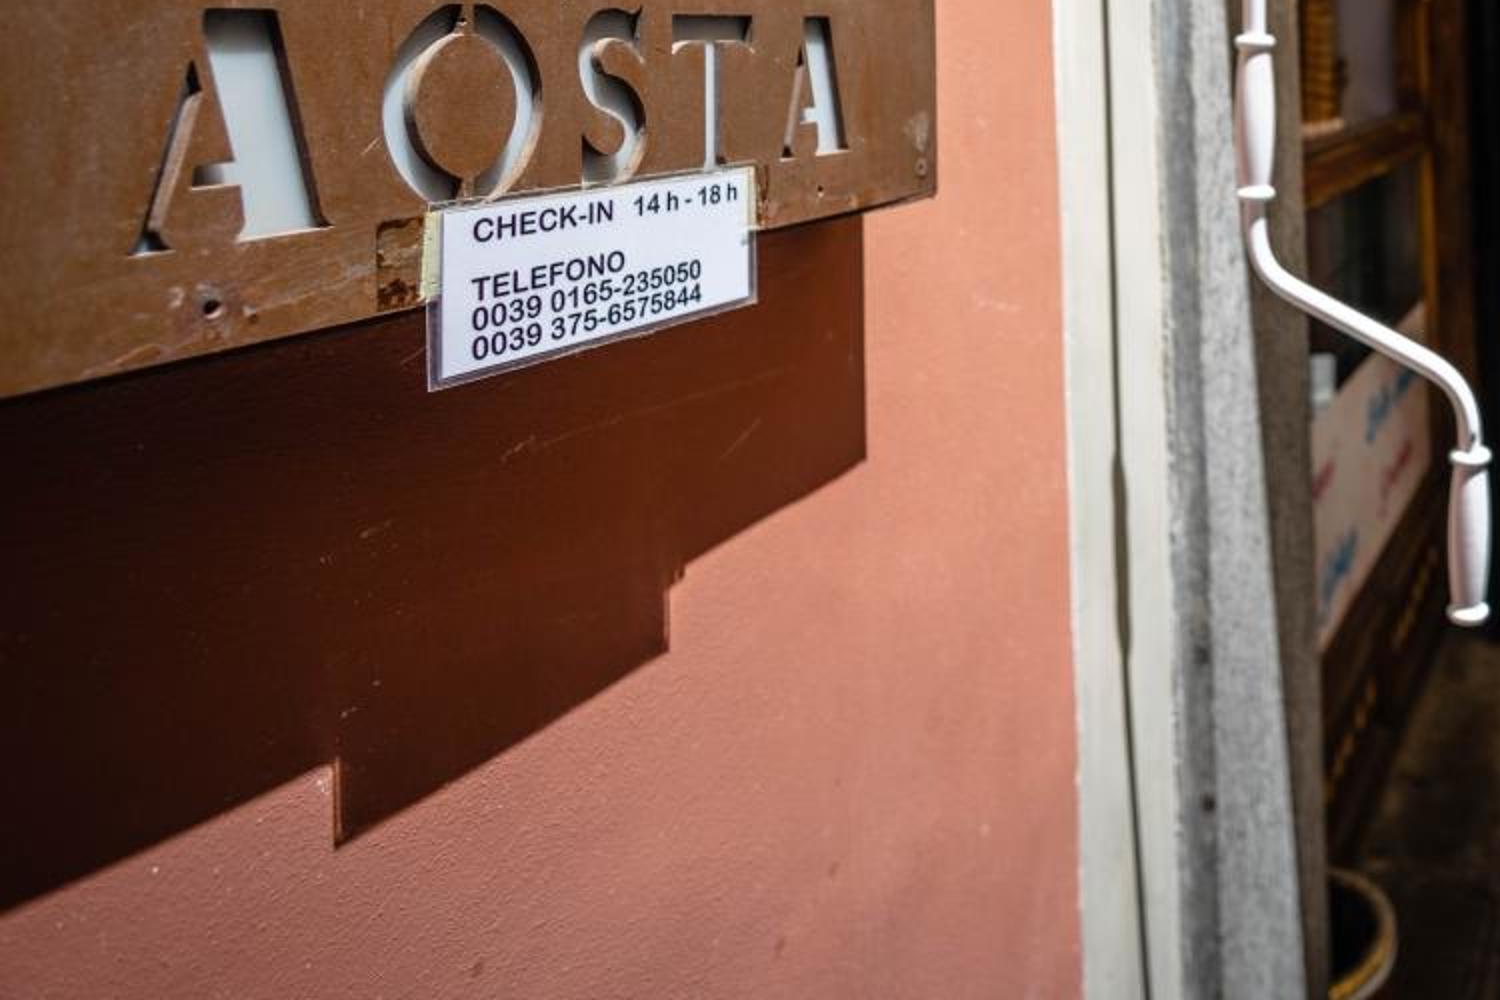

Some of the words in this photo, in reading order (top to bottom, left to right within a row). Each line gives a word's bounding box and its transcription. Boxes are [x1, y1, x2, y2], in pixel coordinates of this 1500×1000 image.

[129, 2, 849, 256] AOSTA
[473, 200, 614, 243] CHECK-IN
[634, 193, 660, 216] 14
[699, 185, 722, 207] 18
[472, 250, 625, 301] TELEFONO
[472, 296, 541, 331] 0039
[551, 259, 702, 313] 0165-235050
[472, 324, 542, 361] 0039
[551, 284, 702, 341] 375-6575844
